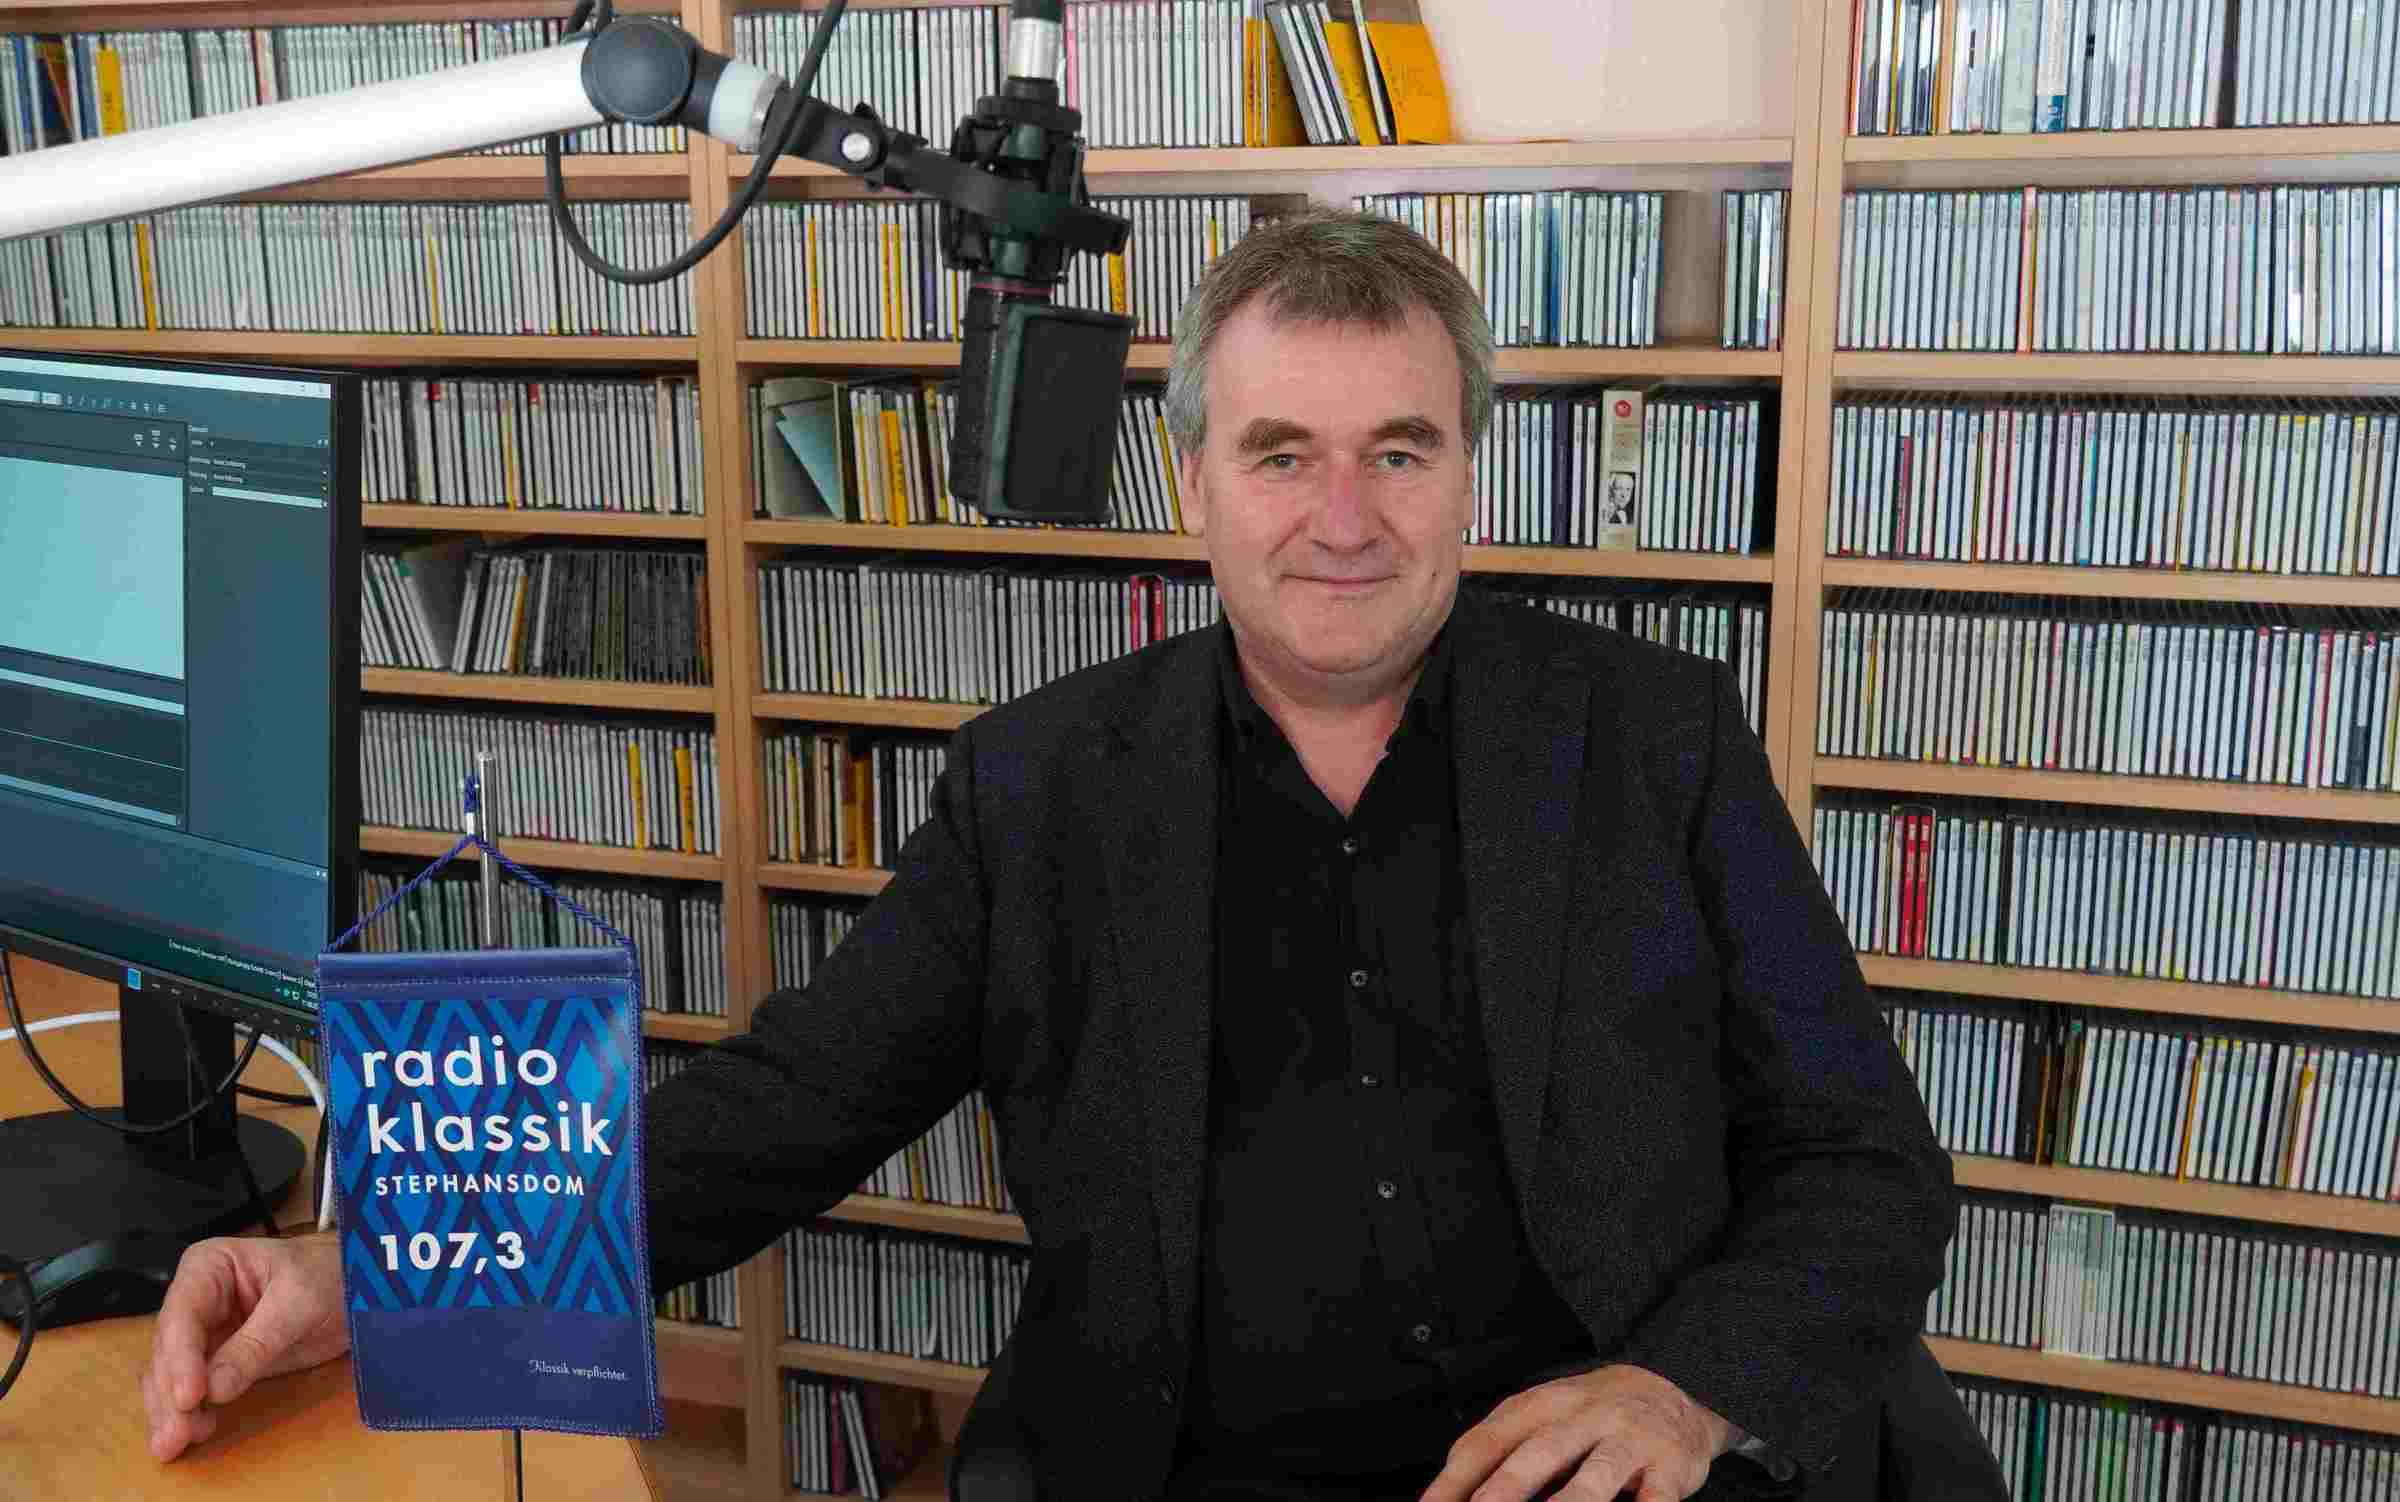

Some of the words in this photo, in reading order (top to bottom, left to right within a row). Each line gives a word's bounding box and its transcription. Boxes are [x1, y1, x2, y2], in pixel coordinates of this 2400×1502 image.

[362, 1034, 559, 1088] radio
[367, 1100, 613, 1156] klassik
[375, 1172, 585, 1197] STEPHANSDOM
[379, 1231, 526, 1275] 107,3
[528, 1359, 570, 1374] Klassik
